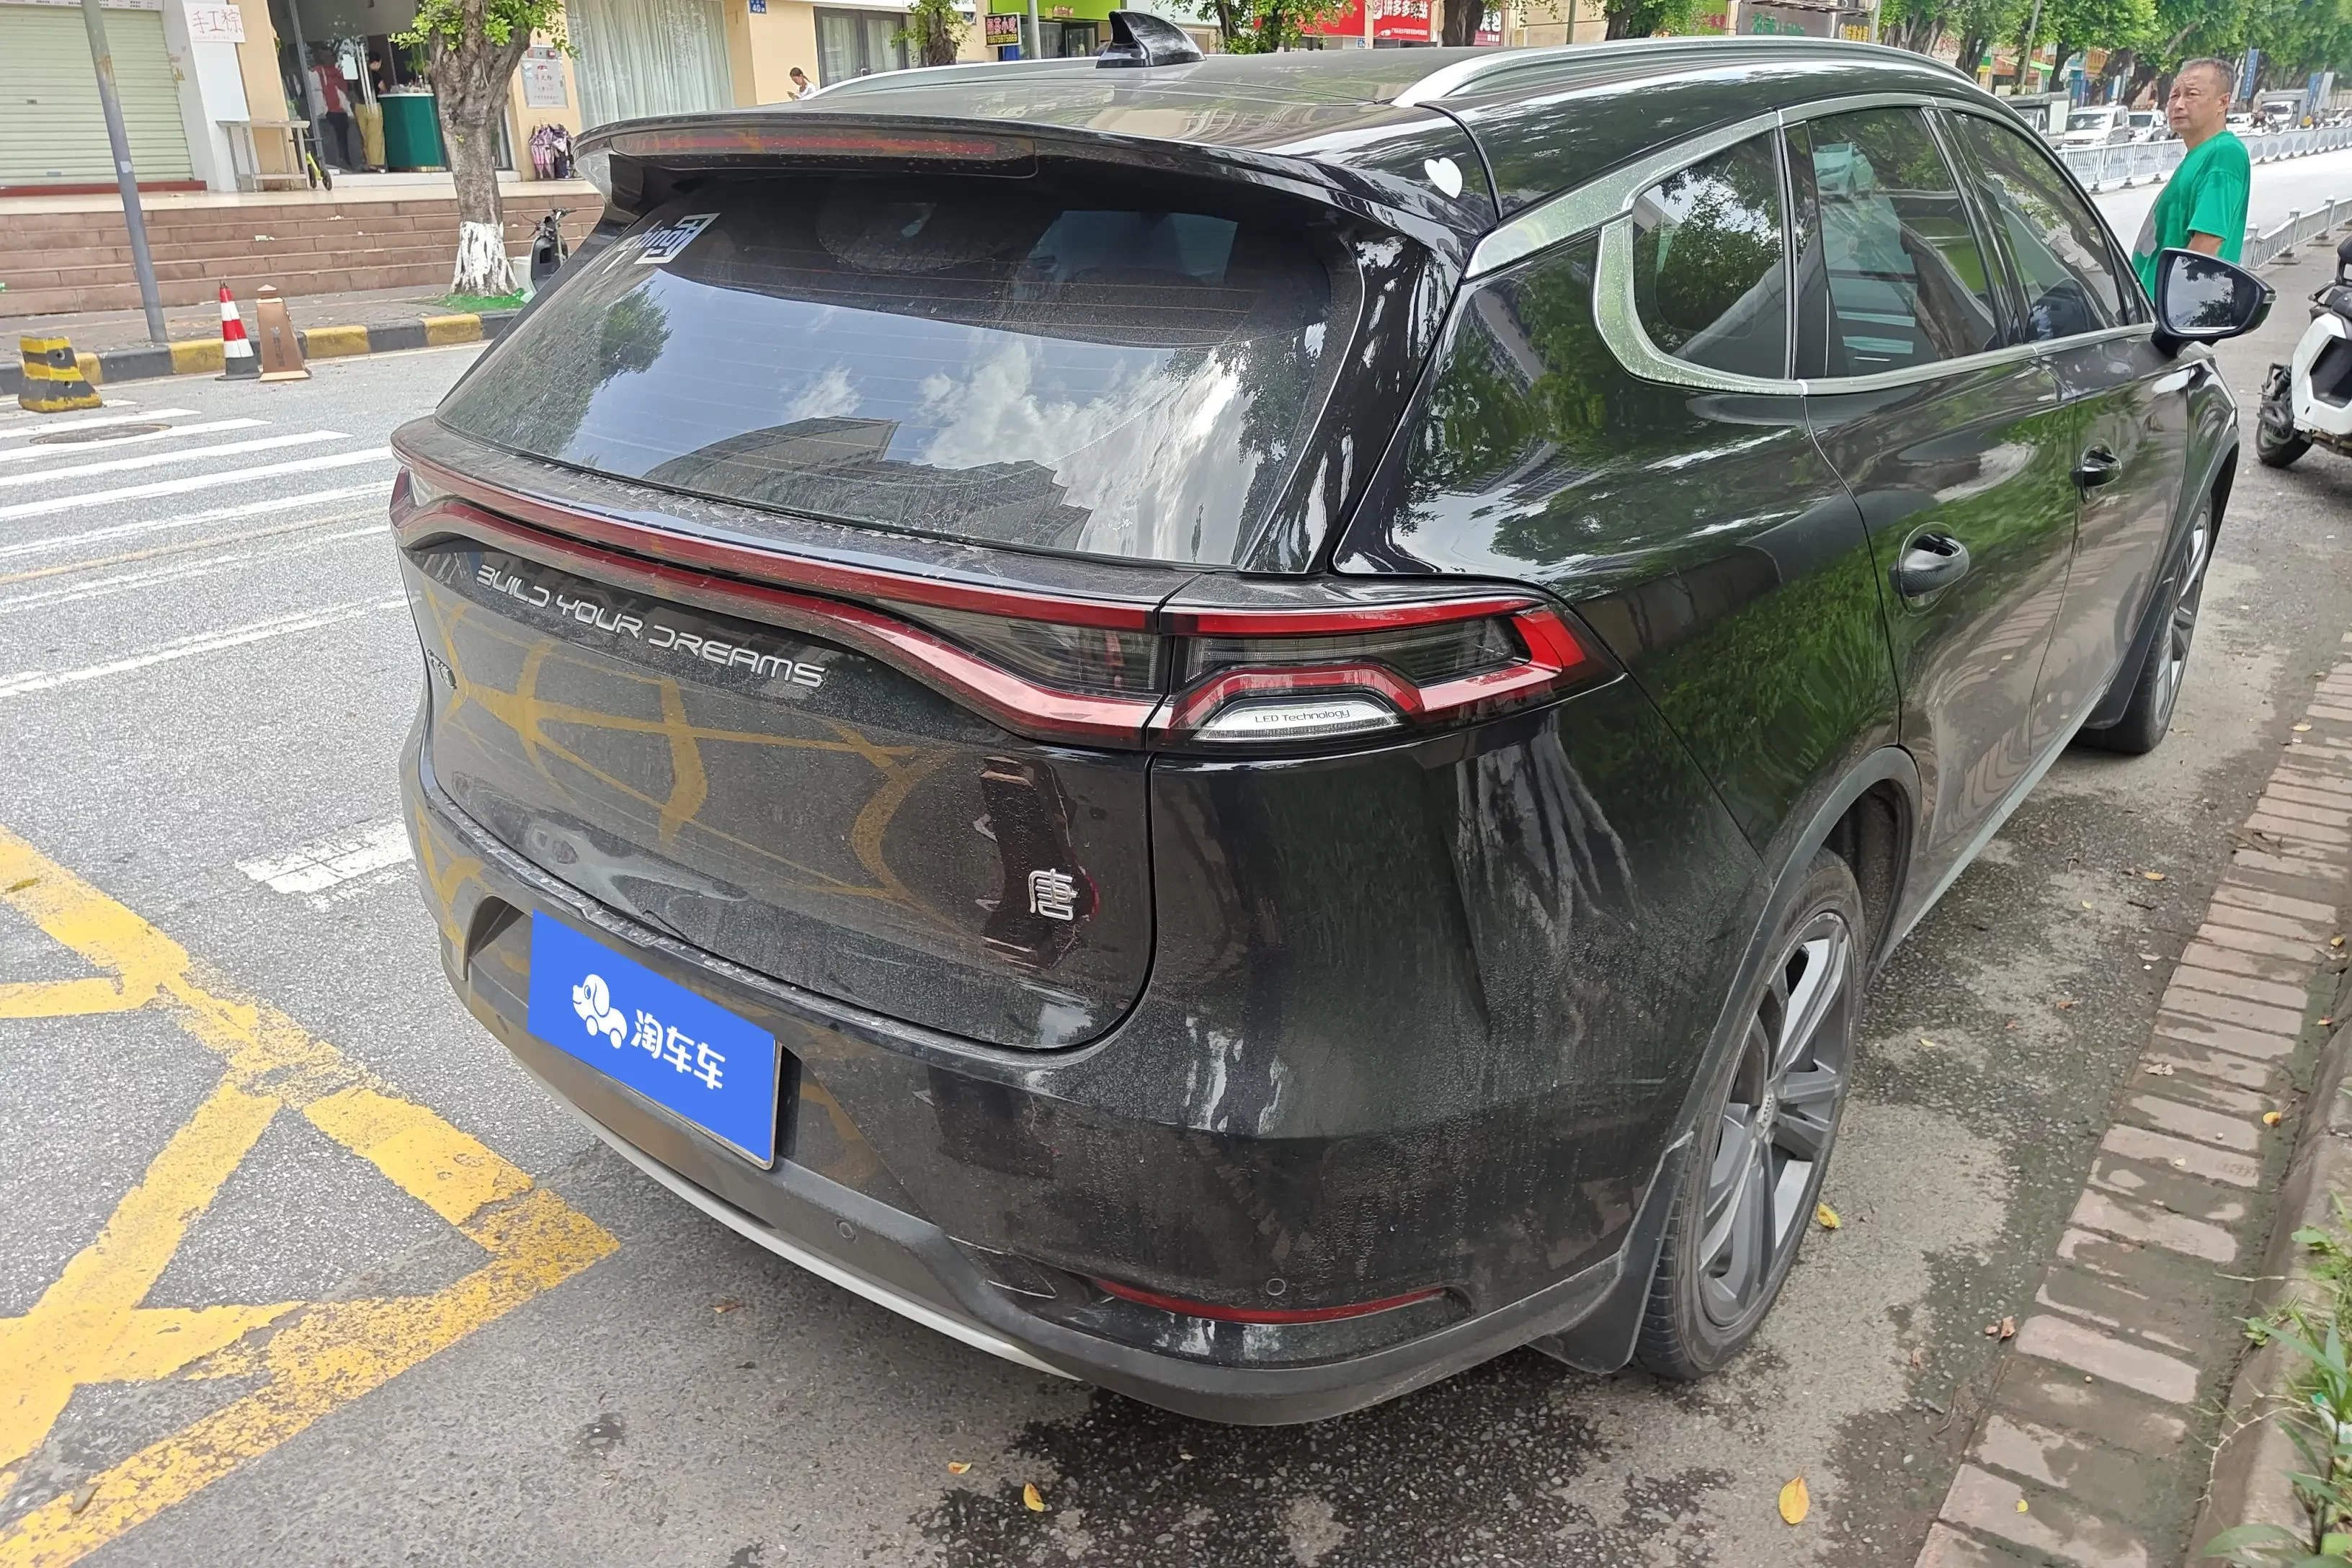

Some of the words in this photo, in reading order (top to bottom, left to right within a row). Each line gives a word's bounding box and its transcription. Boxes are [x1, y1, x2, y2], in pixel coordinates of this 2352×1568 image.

[476, 564, 551, 608] BUILD
[556, 594, 643, 639] YOUR
[648, 624, 827, 687] DREAMS
[1255, 714, 1279, 723] LED
[1282, 709, 1350, 722] Technology
[1028, 868, 1078, 921] 唐
